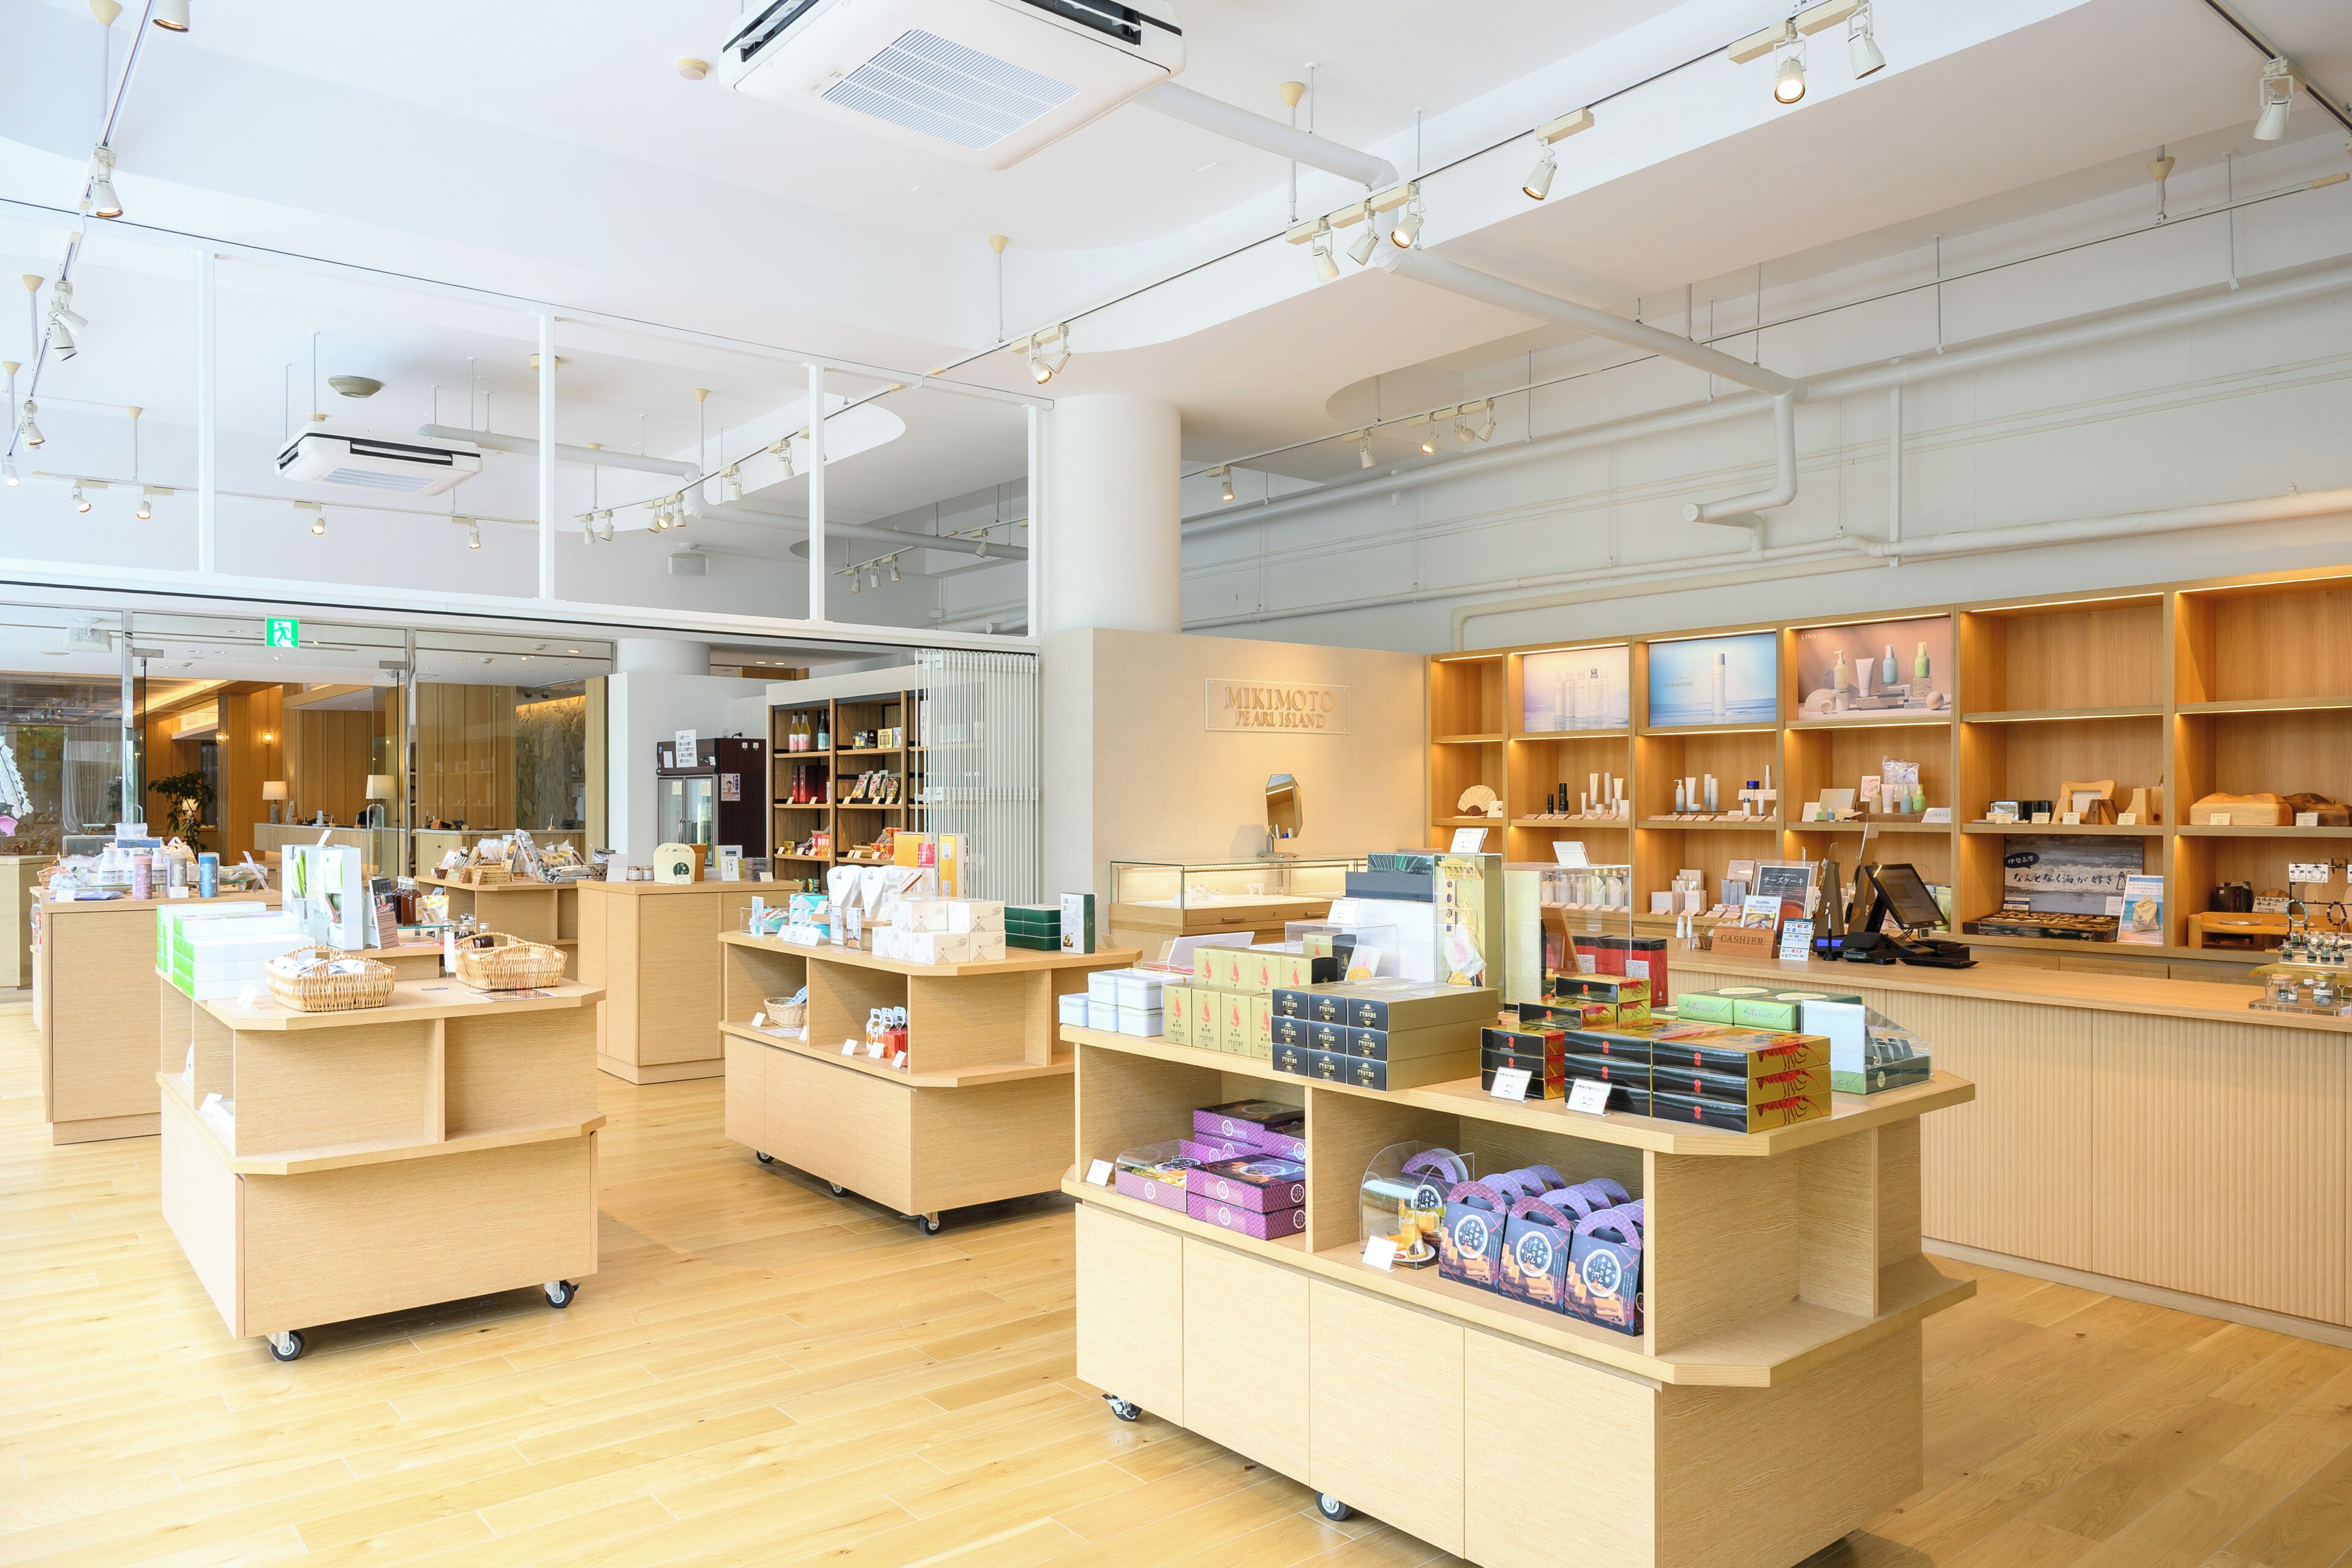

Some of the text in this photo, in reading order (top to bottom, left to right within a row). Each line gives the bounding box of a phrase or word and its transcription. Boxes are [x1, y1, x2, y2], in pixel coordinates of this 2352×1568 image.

[1224, 686, 1336, 712] MIKIMOTO
[1235, 710, 1325, 728] PEARL ISLAND
[1763, 876, 1804, 886] チーズケーキ
[2013, 873, 2113, 885] なんとなく海が好き
[1720, 934, 1764, 946] CASHIER
